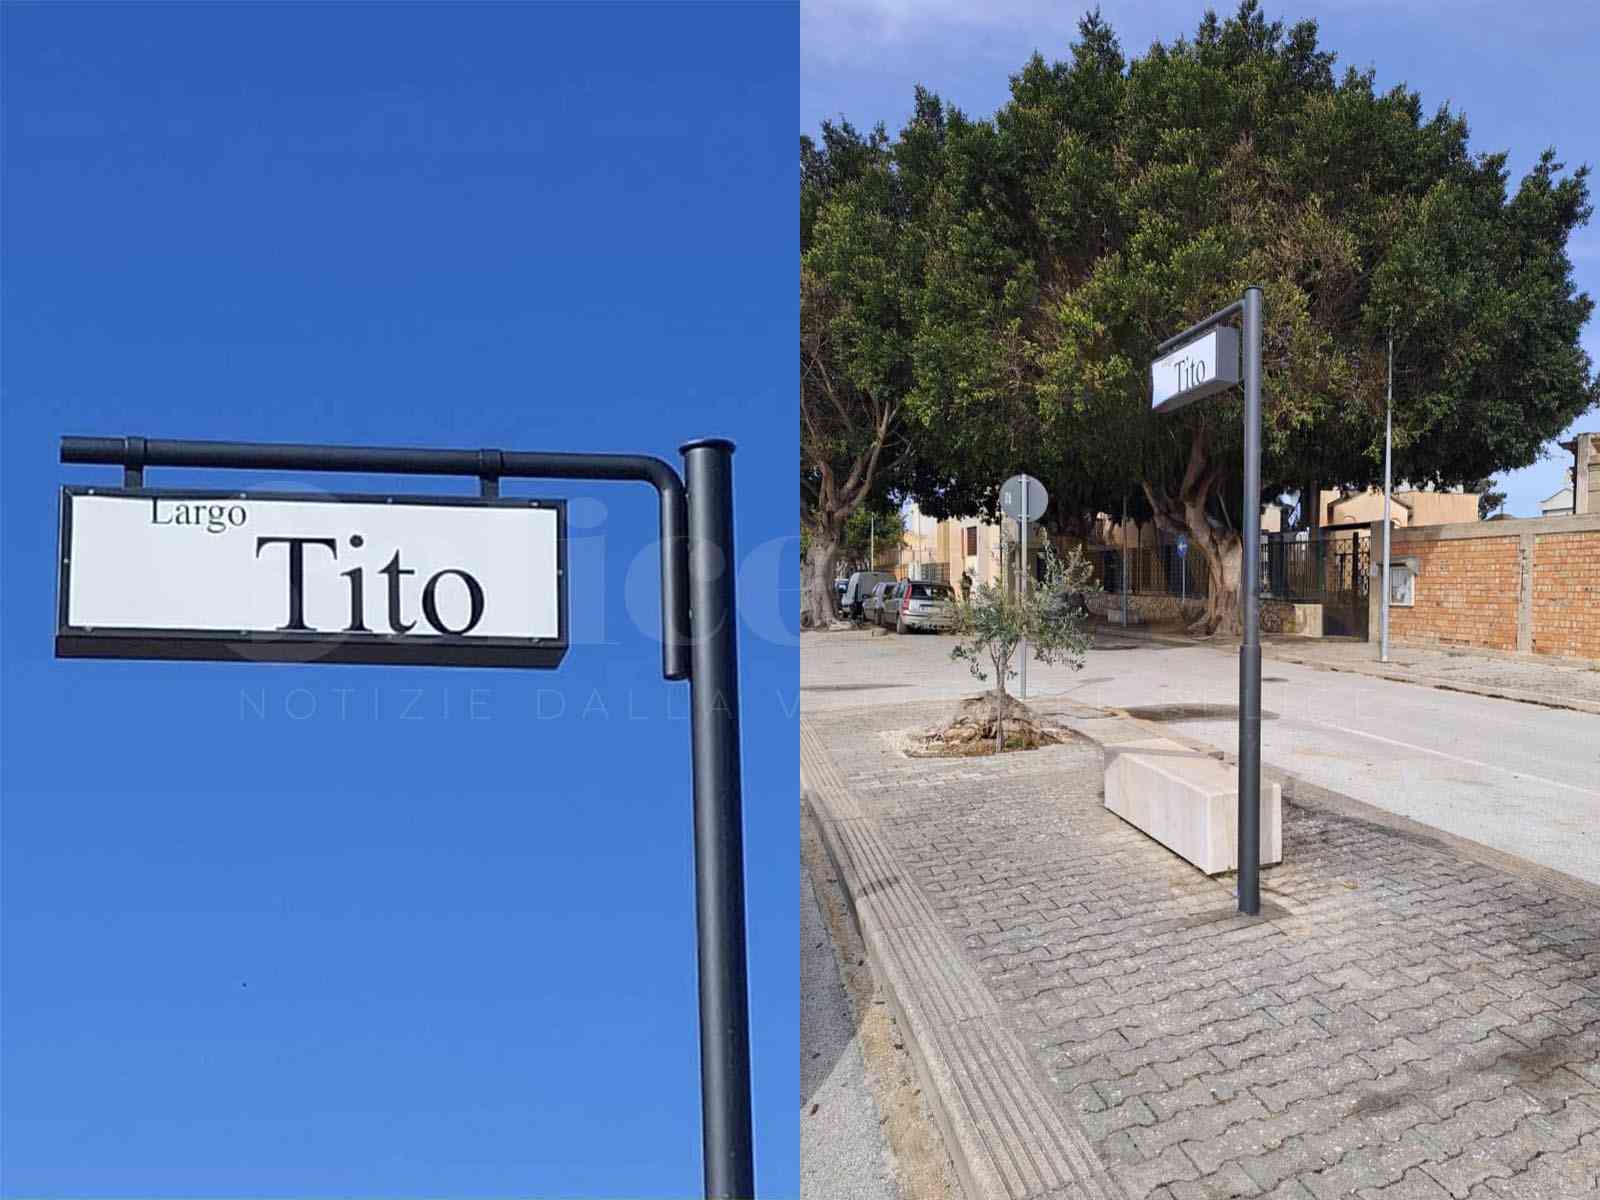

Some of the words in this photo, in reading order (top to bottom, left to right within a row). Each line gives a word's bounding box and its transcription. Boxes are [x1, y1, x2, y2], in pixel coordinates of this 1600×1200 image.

[1174, 355, 1207, 393] Tito
[151, 499, 247, 533] Largo
[255, 534, 485, 636] Tito
